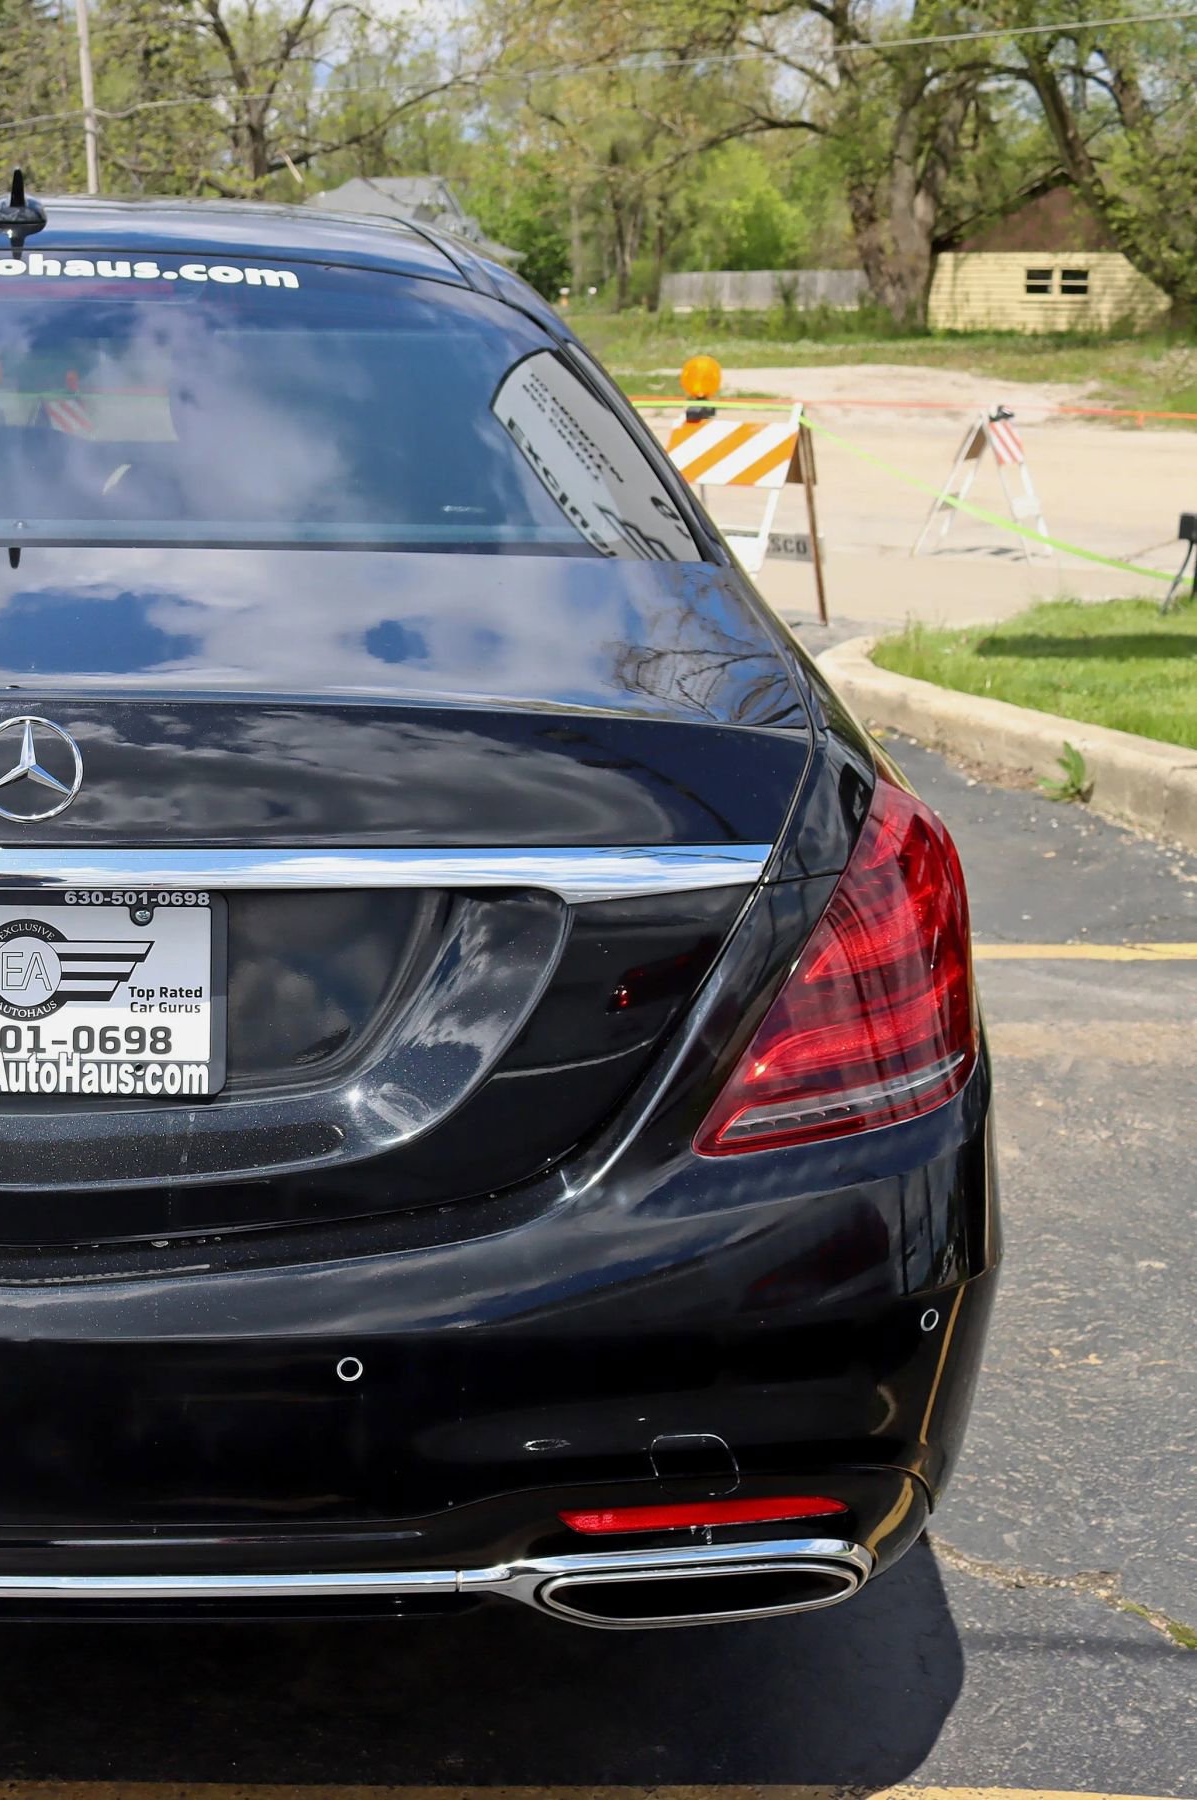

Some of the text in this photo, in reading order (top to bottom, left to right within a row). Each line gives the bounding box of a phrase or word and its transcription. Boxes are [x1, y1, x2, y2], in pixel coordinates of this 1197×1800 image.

[64, 891, 210, 906] 630-501-0698
[1, 951, 53, 991] EA
[128, 986, 203, 1001] Top Rated
[130, 1002, 201, 1013] Car Gurus
